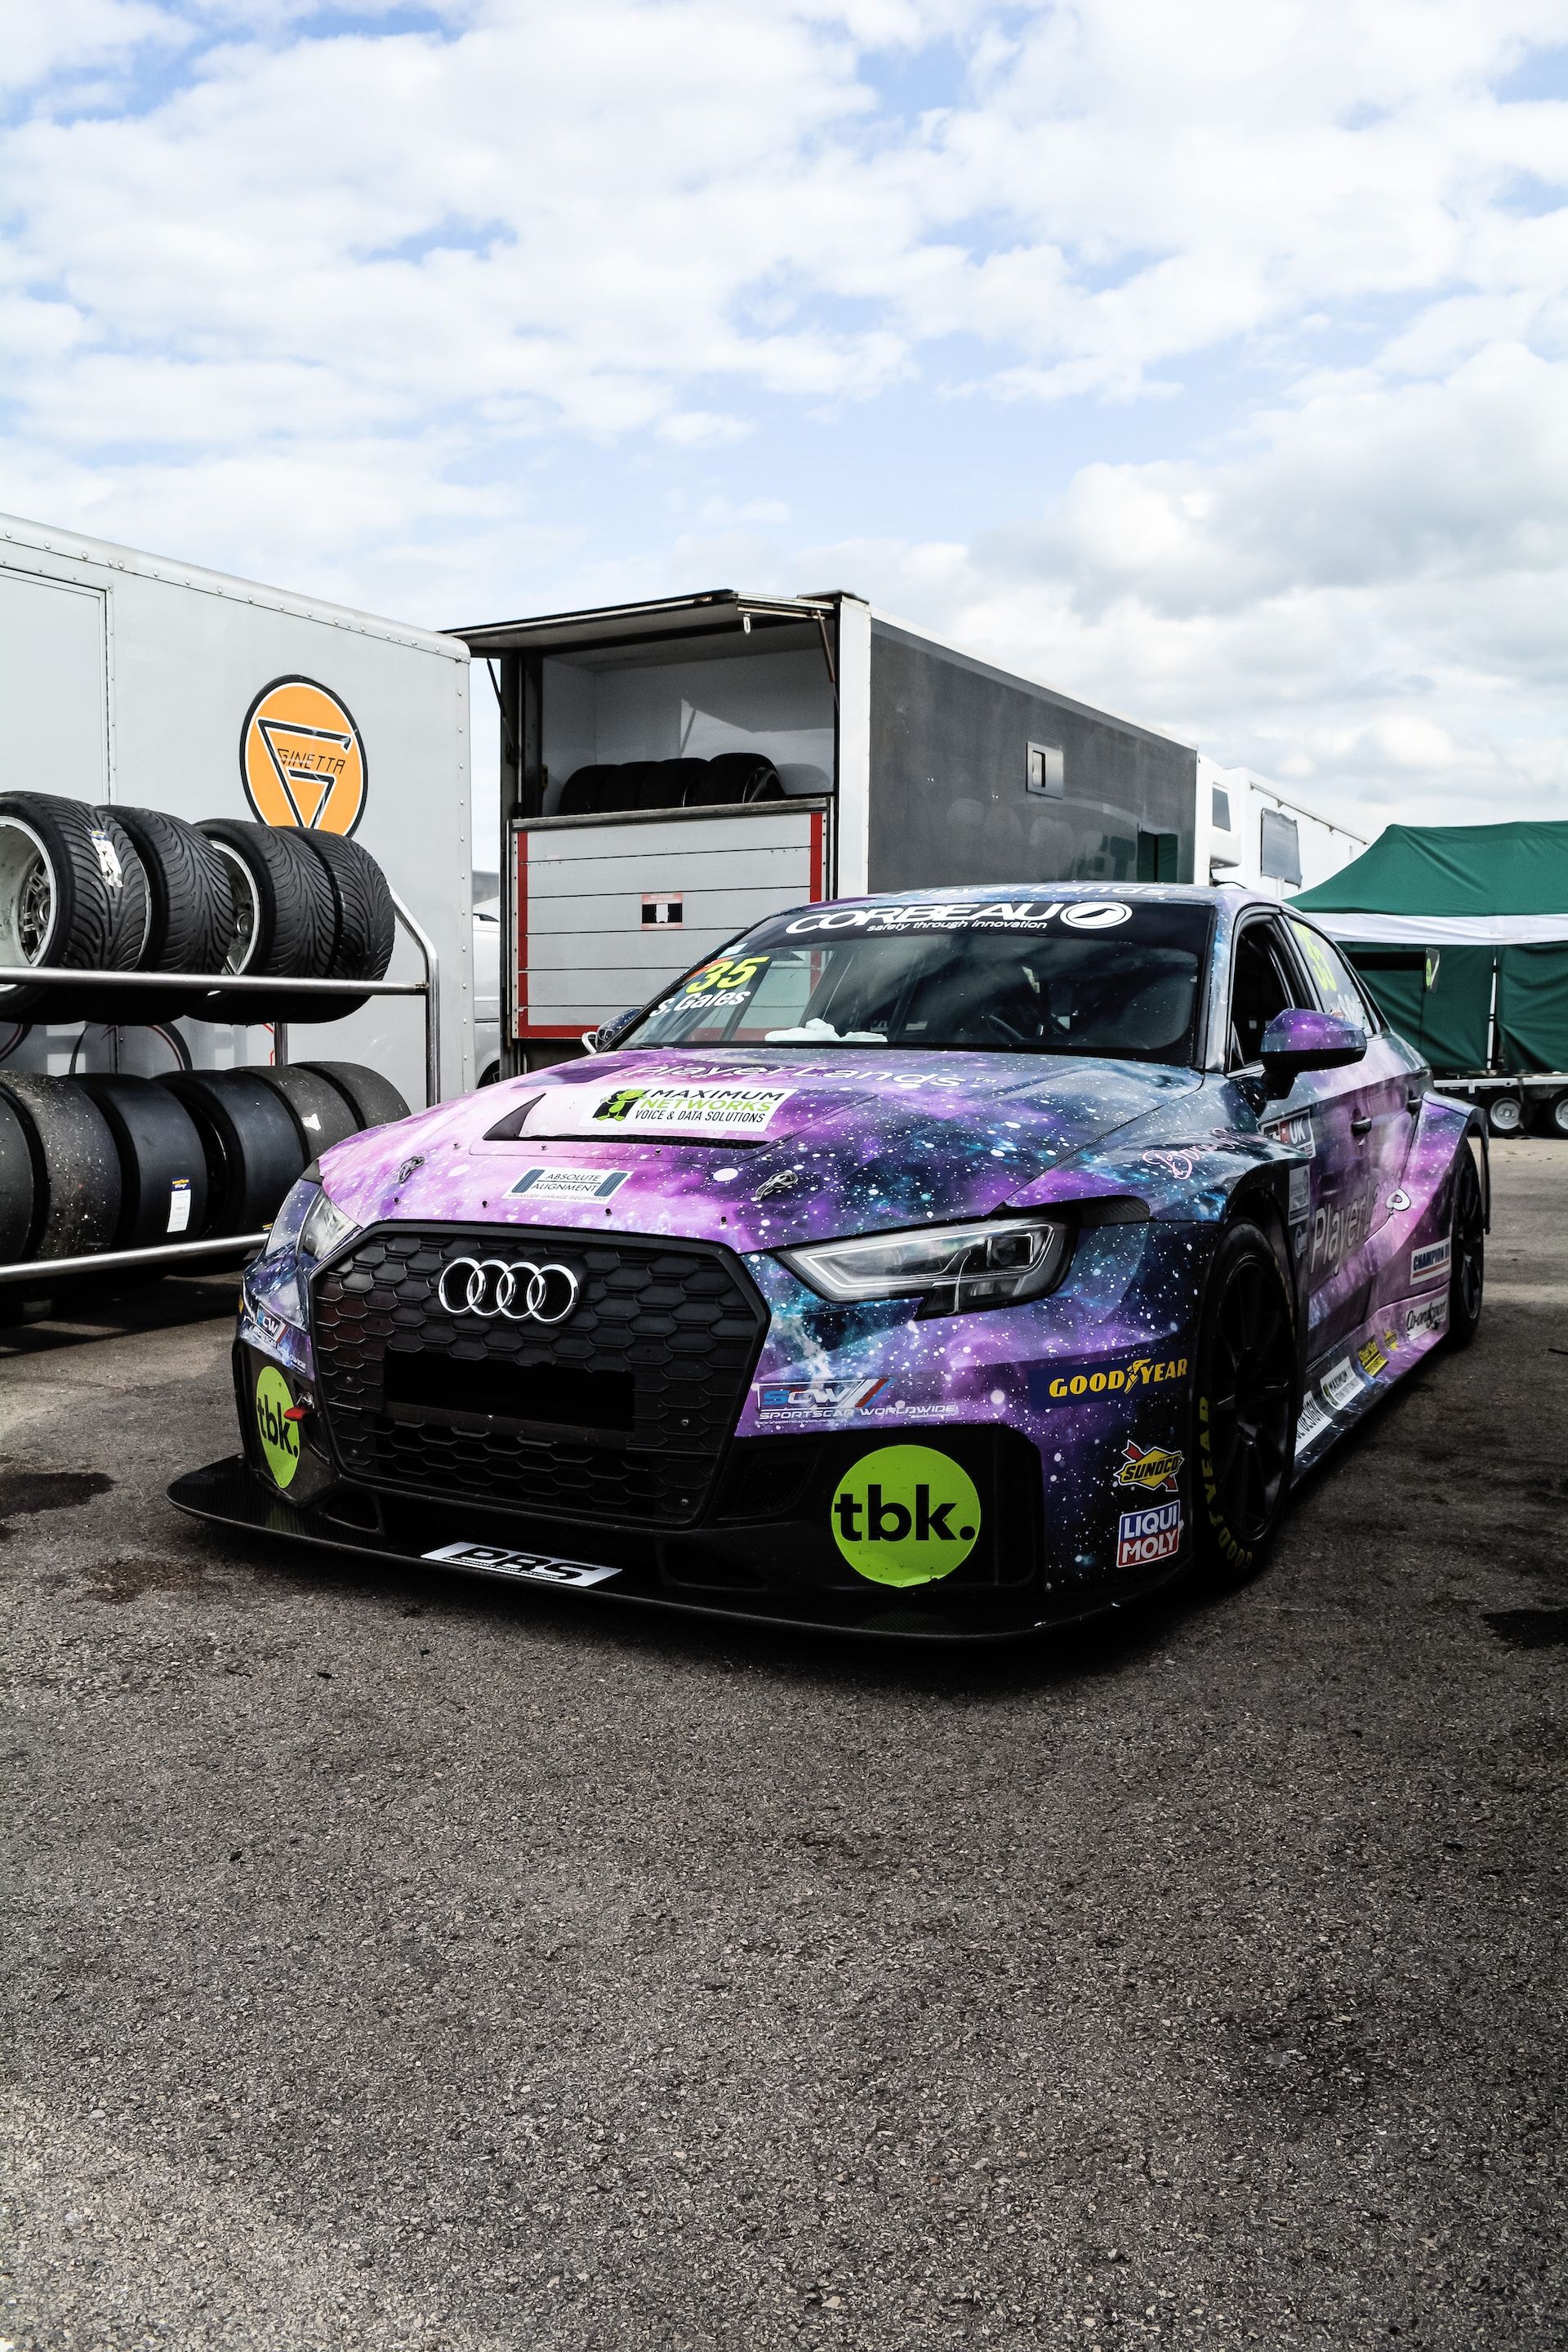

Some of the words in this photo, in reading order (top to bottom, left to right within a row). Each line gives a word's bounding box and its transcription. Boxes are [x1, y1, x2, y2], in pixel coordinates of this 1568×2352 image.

[278, 748, 346, 774] GINETTA
[786, 902, 1065, 934] CORBEAU
[866, 923, 908, 933] safety
[912, 920, 968, 929] through
[971, 920, 1048, 929] innovation
[685, 956, 770, 994] 35
[674, 989, 751, 1012] Gales
[624, 1064, 967, 1087] PlayerLands
[639, 1098, 773, 1112] NETWORKS
[650, 1089, 786, 1101] MAXIMUM
[635, 1109, 666, 1120] VOICE
[667, 1110, 675, 1120] &
[678, 1110, 702, 1121] DATA
[706, 1111, 765, 1123] SOLUTIONS
[1289, 1117, 1307, 1144] UK
[531, 1183, 599, 1192] ALIGNMENT
[546, 1174, 602, 1182] ABSOLUTE
[763, 1387, 854, 1405] SCW
[759, 1408, 855, 1419] SPORTSCAR
[859, 1404, 957, 1416] WORLDWIDE
[1124, 1455, 1180, 1481] SUNOCO
[834, 1484, 976, 1542] tbk.
[1124, 1505, 1178, 1539] LIQUI
[1121, 1528, 1178, 1564] MOLY
